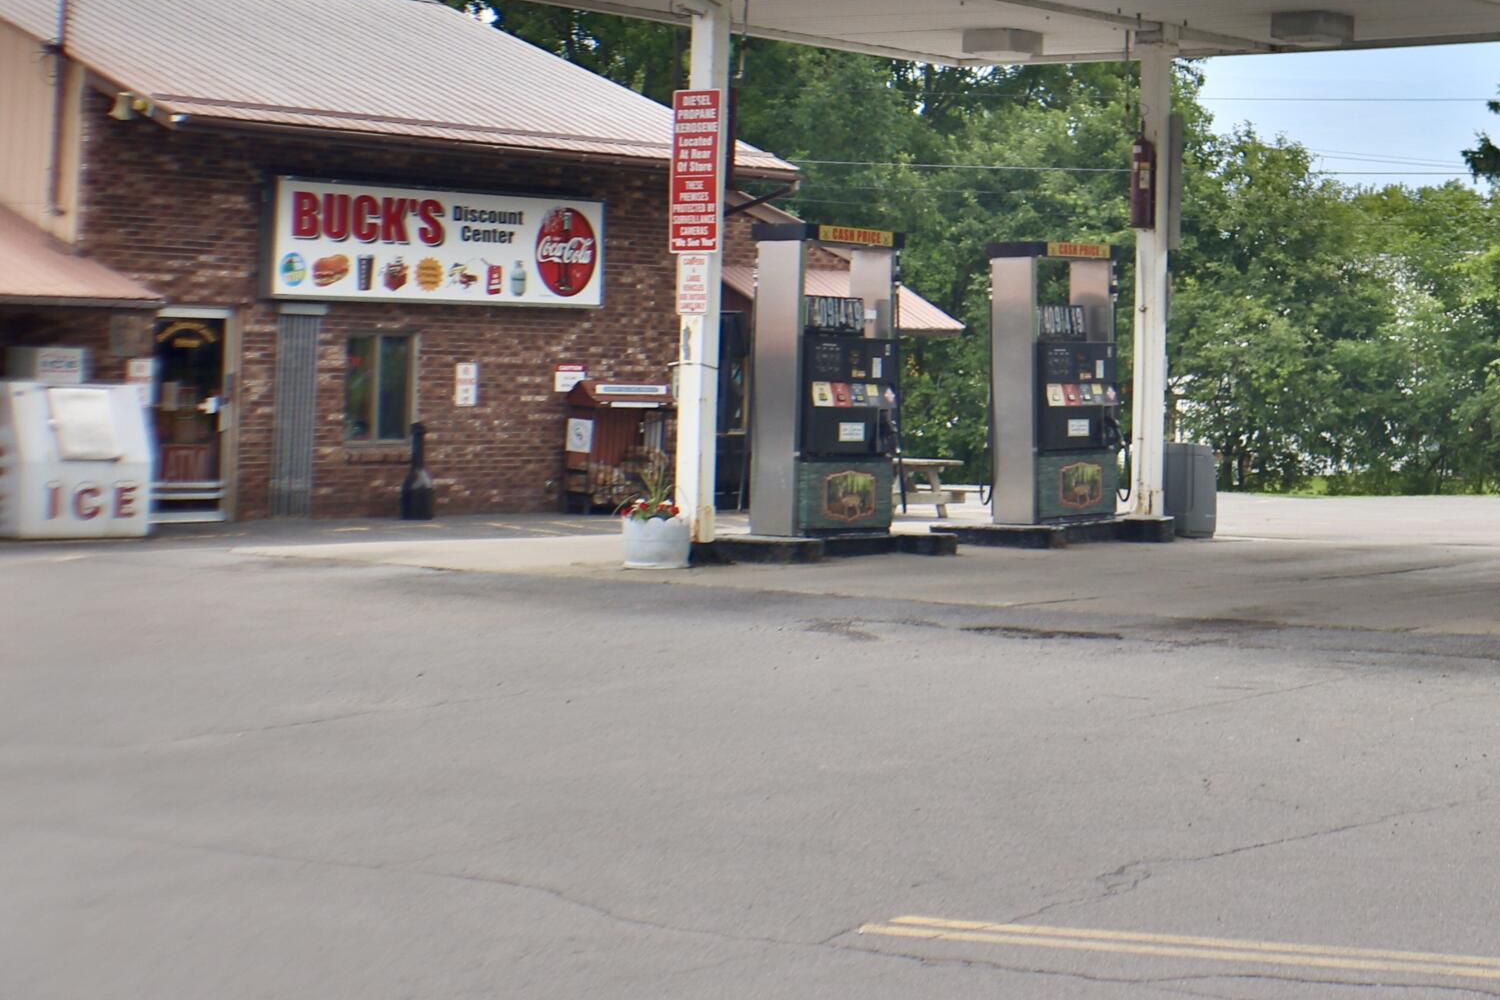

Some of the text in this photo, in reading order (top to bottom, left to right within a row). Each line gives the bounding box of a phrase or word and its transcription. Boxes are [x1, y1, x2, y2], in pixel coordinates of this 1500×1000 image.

[682, 95, 711, 106] DIESEL
[678, 108, 716, 120] PROPANE
[678, 136, 712, 147] Located
[292, 190, 445, 246] BUCK'S
[453, 204, 524, 226] Discount
[461, 225, 514, 245] Center
[832, 228, 881, 244] CASH PRICE
[1059, 244, 1099, 256] CASH PRICE
[46, 481, 139, 520] ICE
